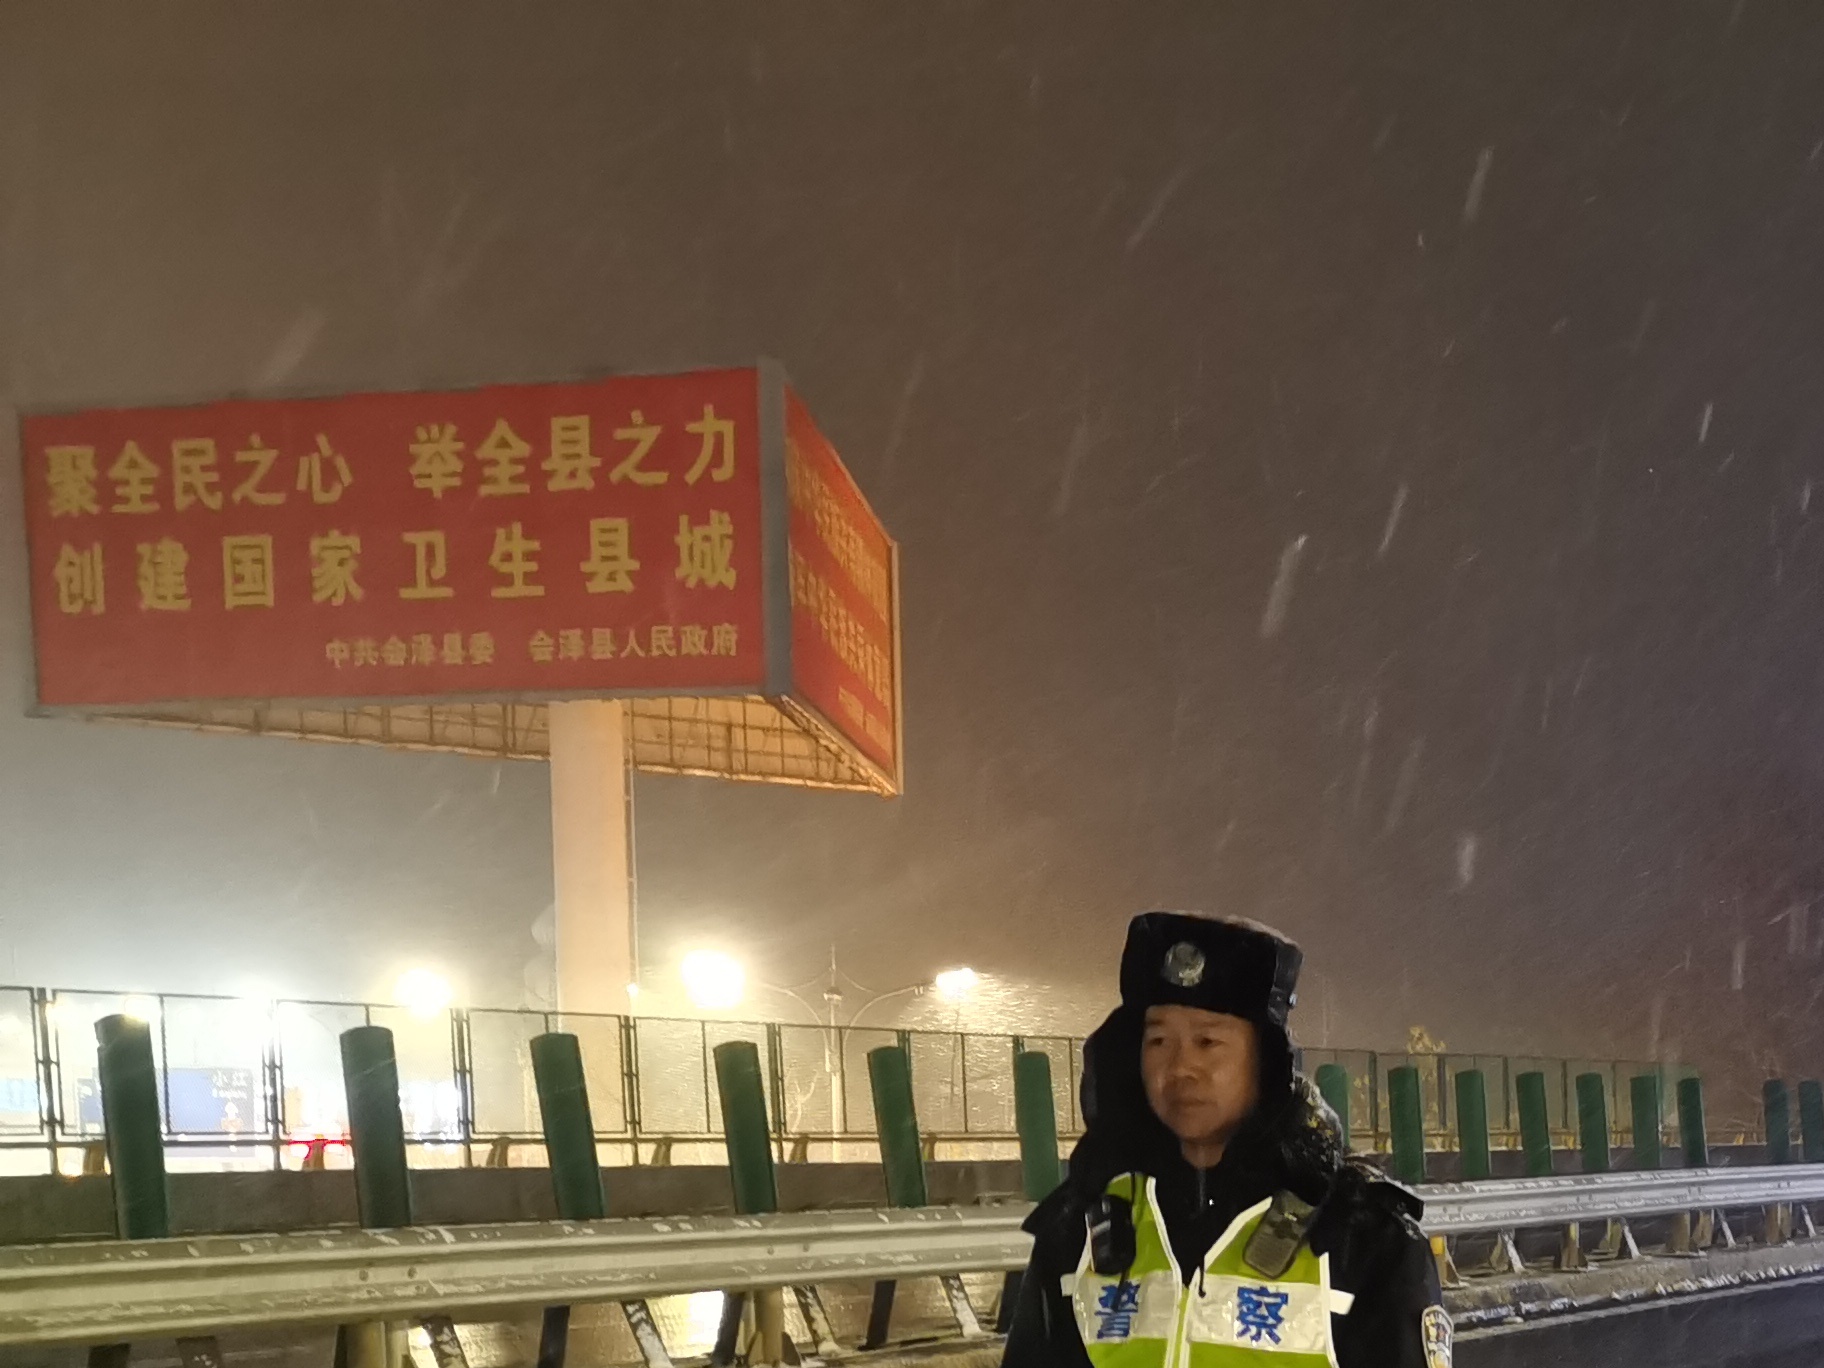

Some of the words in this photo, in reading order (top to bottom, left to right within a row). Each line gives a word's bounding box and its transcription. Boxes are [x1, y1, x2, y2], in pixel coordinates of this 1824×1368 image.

[46, 433, 354, 517] 聚全民之心
[409, 402, 735, 499] 举全县之力
[54, 508, 737, 615] 创建国家卫生县城
[529, 623, 738, 662] 会泽县人民政府
[1095, 1281, 1289, 1345] 警察
